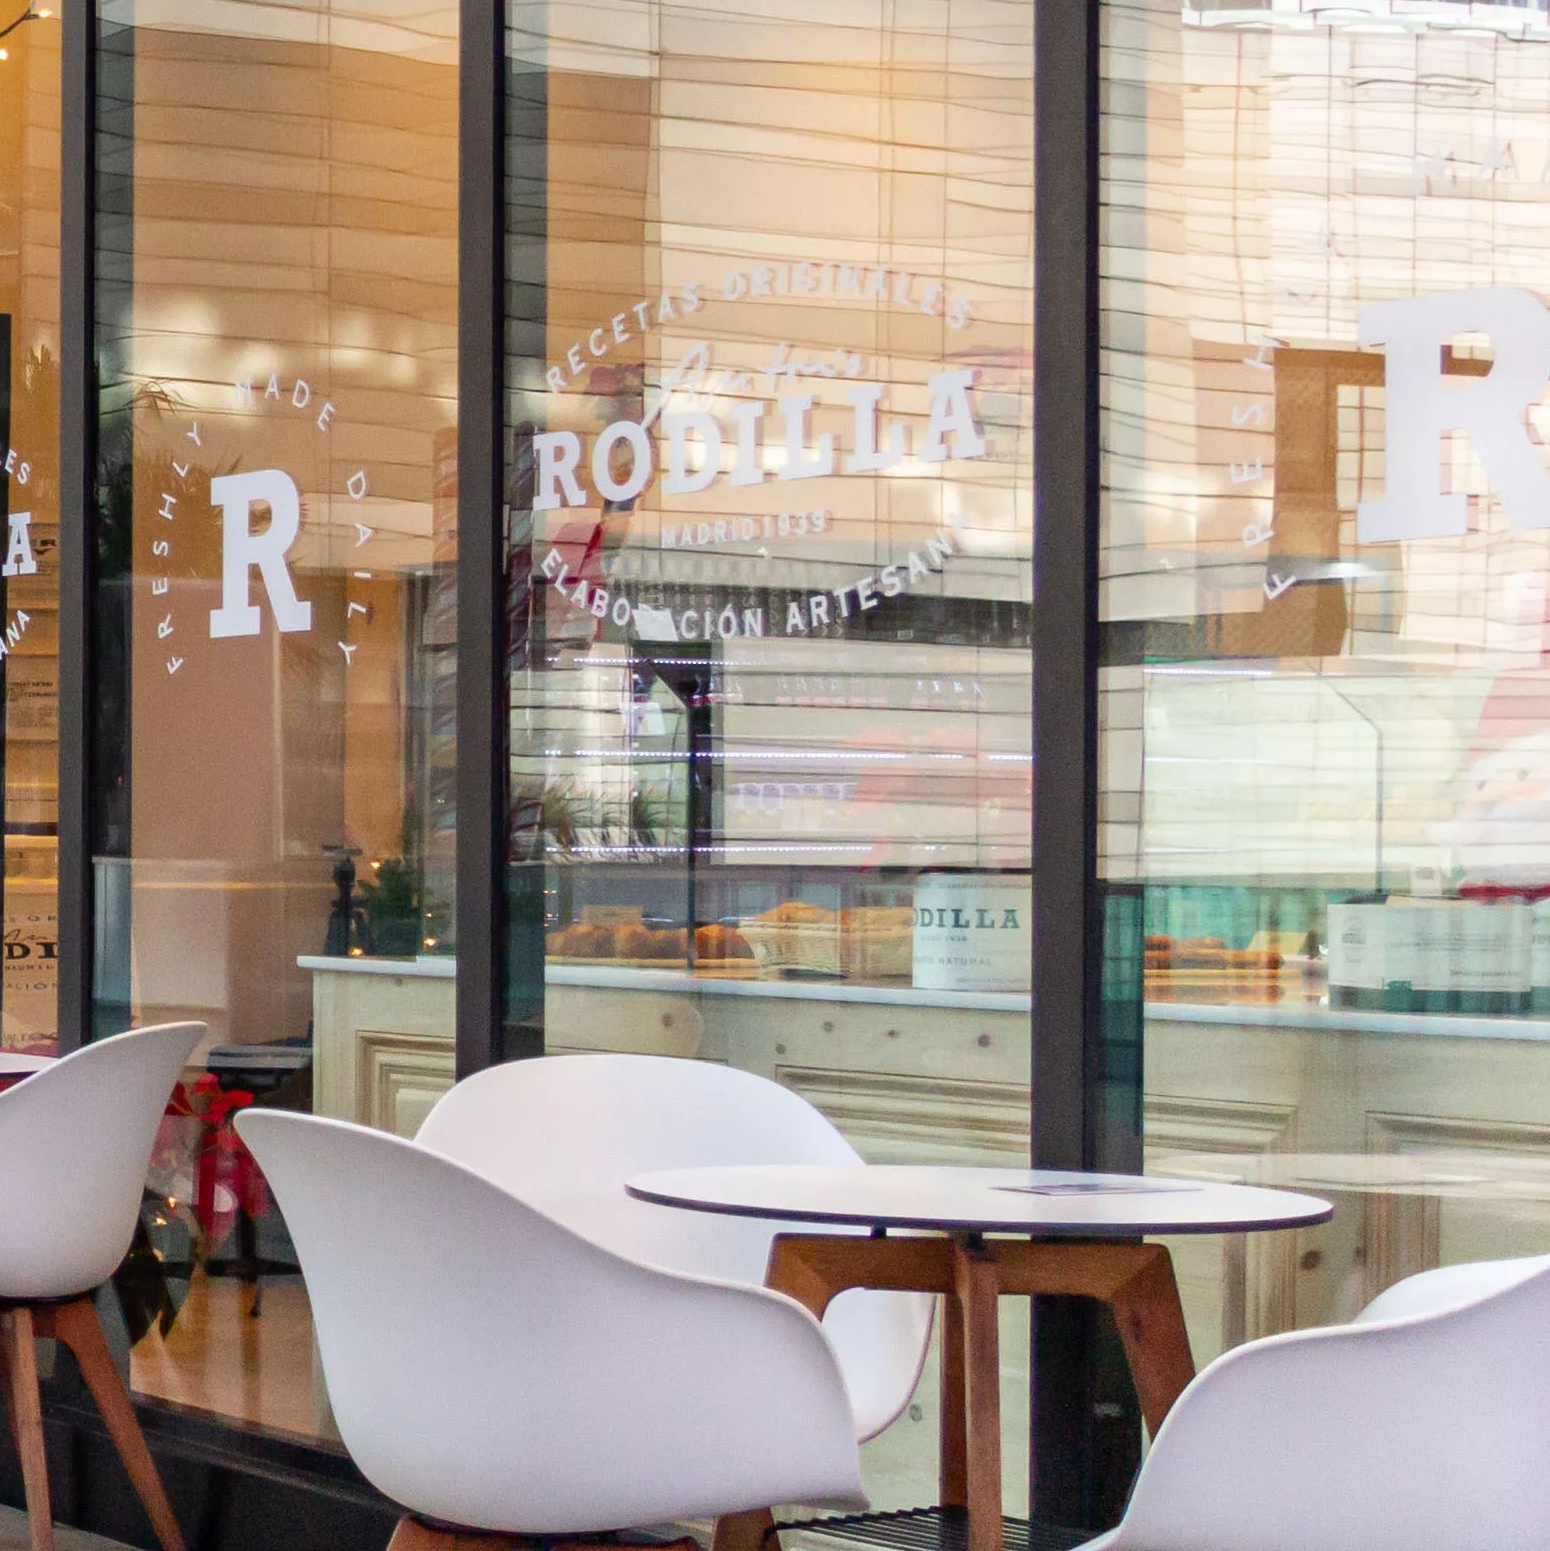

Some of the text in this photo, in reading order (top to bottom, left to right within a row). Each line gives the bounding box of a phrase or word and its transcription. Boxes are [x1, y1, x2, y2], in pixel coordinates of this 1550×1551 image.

[544, 262, 972, 395] RECETAS ORIGINALES
[234, 373, 336, 431] MADE
[532, 369, 986, 511] RODILLA
[1357, 285, 1550, 543] R
[152, 421, 201, 676] FRESHLY
[209, 468, 311, 639] R
[337, 470, 374, 665] DAILY
[540, 548, 763, 641] ELABOCIÓN
[661, 515, 757, 549] MADRID
